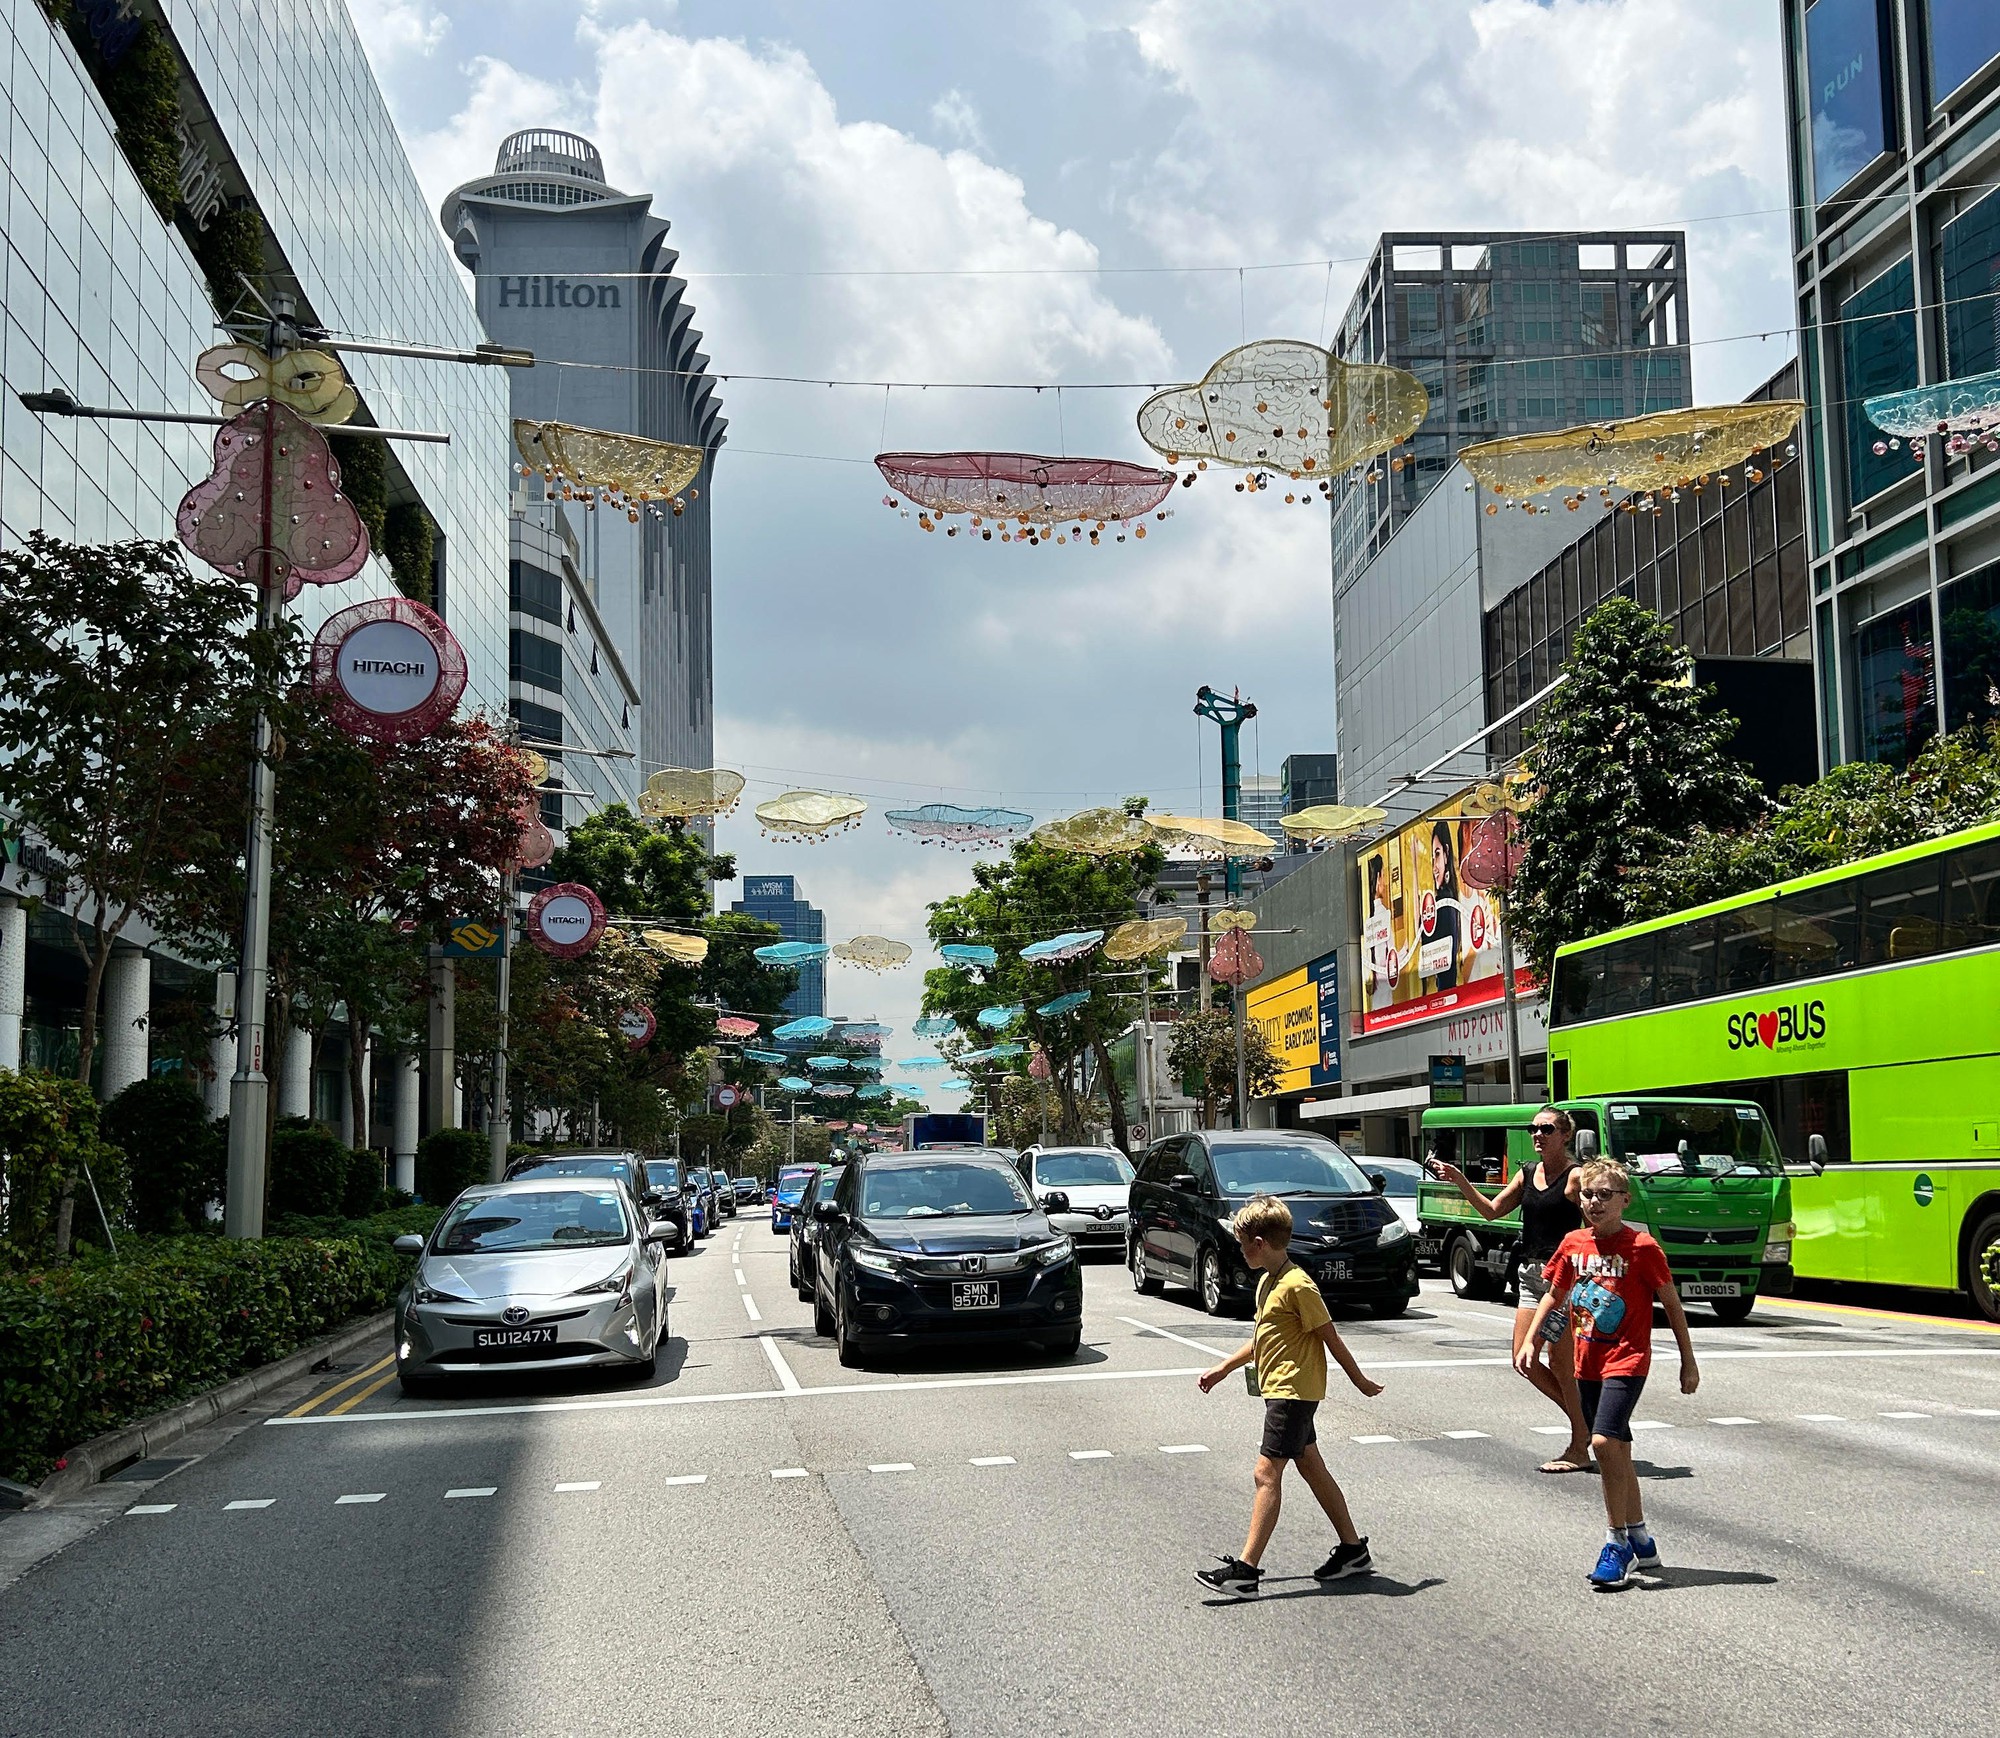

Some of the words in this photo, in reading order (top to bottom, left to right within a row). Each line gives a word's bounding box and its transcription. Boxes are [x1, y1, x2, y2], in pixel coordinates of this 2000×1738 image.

[1824, 53, 1862, 103] RUN
[499, 275, 621, 308] Hilton
[353, 660, 425, 675] HITACHI
[548, 916, 585, 925] HITACHI
[1433, 956, 1449, 970] TRAVEL
[1284, 1004, 1313, 1030] UPCOMING
[1449, 1010, 1503, 1042] MIDPOIN
[1285, 1031, 1302, 1051] EARLY
[1302, 1027, 1317, 1047] 2024
[1448, 1040, 1503, 1057] ORCHAR
[1325, 1260, 1346, 1271] SJR
[1318, 1269, 1354, 1280] 7778E
[963, 1283, 988, 1295] SMN
[954, 1294, 997, 1307] 9570J
[478, 1329, 551, 1346] SLU1247X
